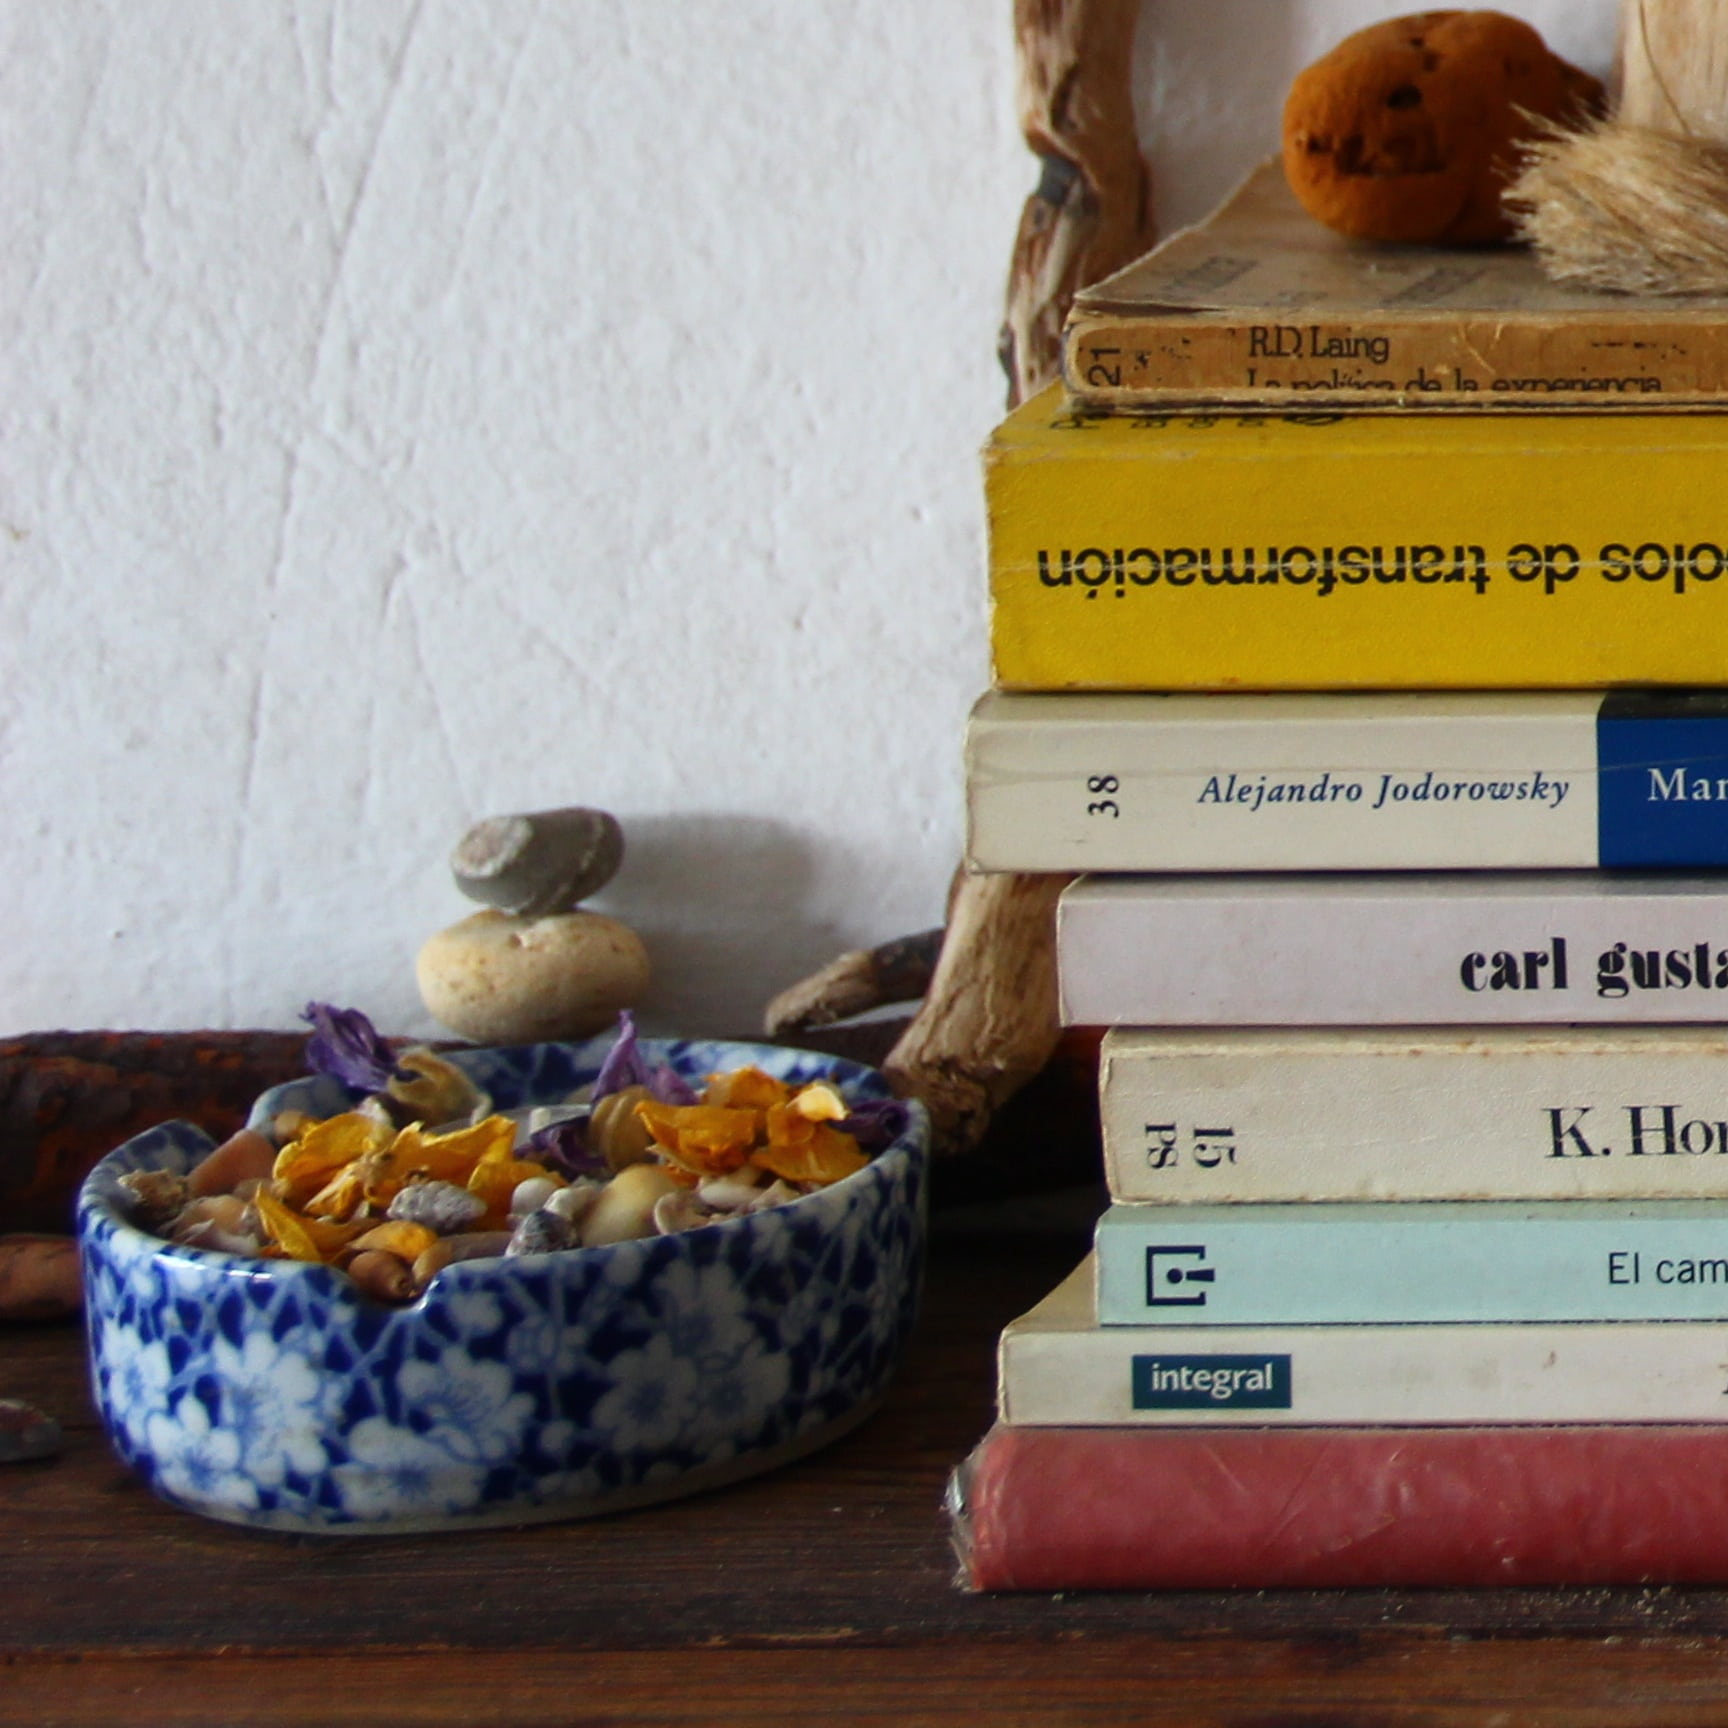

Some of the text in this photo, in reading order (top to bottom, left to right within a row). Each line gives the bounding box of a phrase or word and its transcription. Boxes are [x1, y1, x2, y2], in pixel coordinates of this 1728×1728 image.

[1309, 325, 1390, 366] Laing
[1037, 544, 1491, 600] transformación
[1507, 543, 1580, 595] de
[1087, 774, 1120, 818] 38
[1197, 770, 1570, 812] Alejandro Jodorowsky
[1460, 937, 1568, 992] carl
[1144, 1123, 1176, 1170] PS
[1193, 1127, 1236, 1169] 15
[1543, 1106, 1612, 1159] K.
[1608, 1251, 1640, 1285] El
[1152, 1362, 1273, 1400] integral
